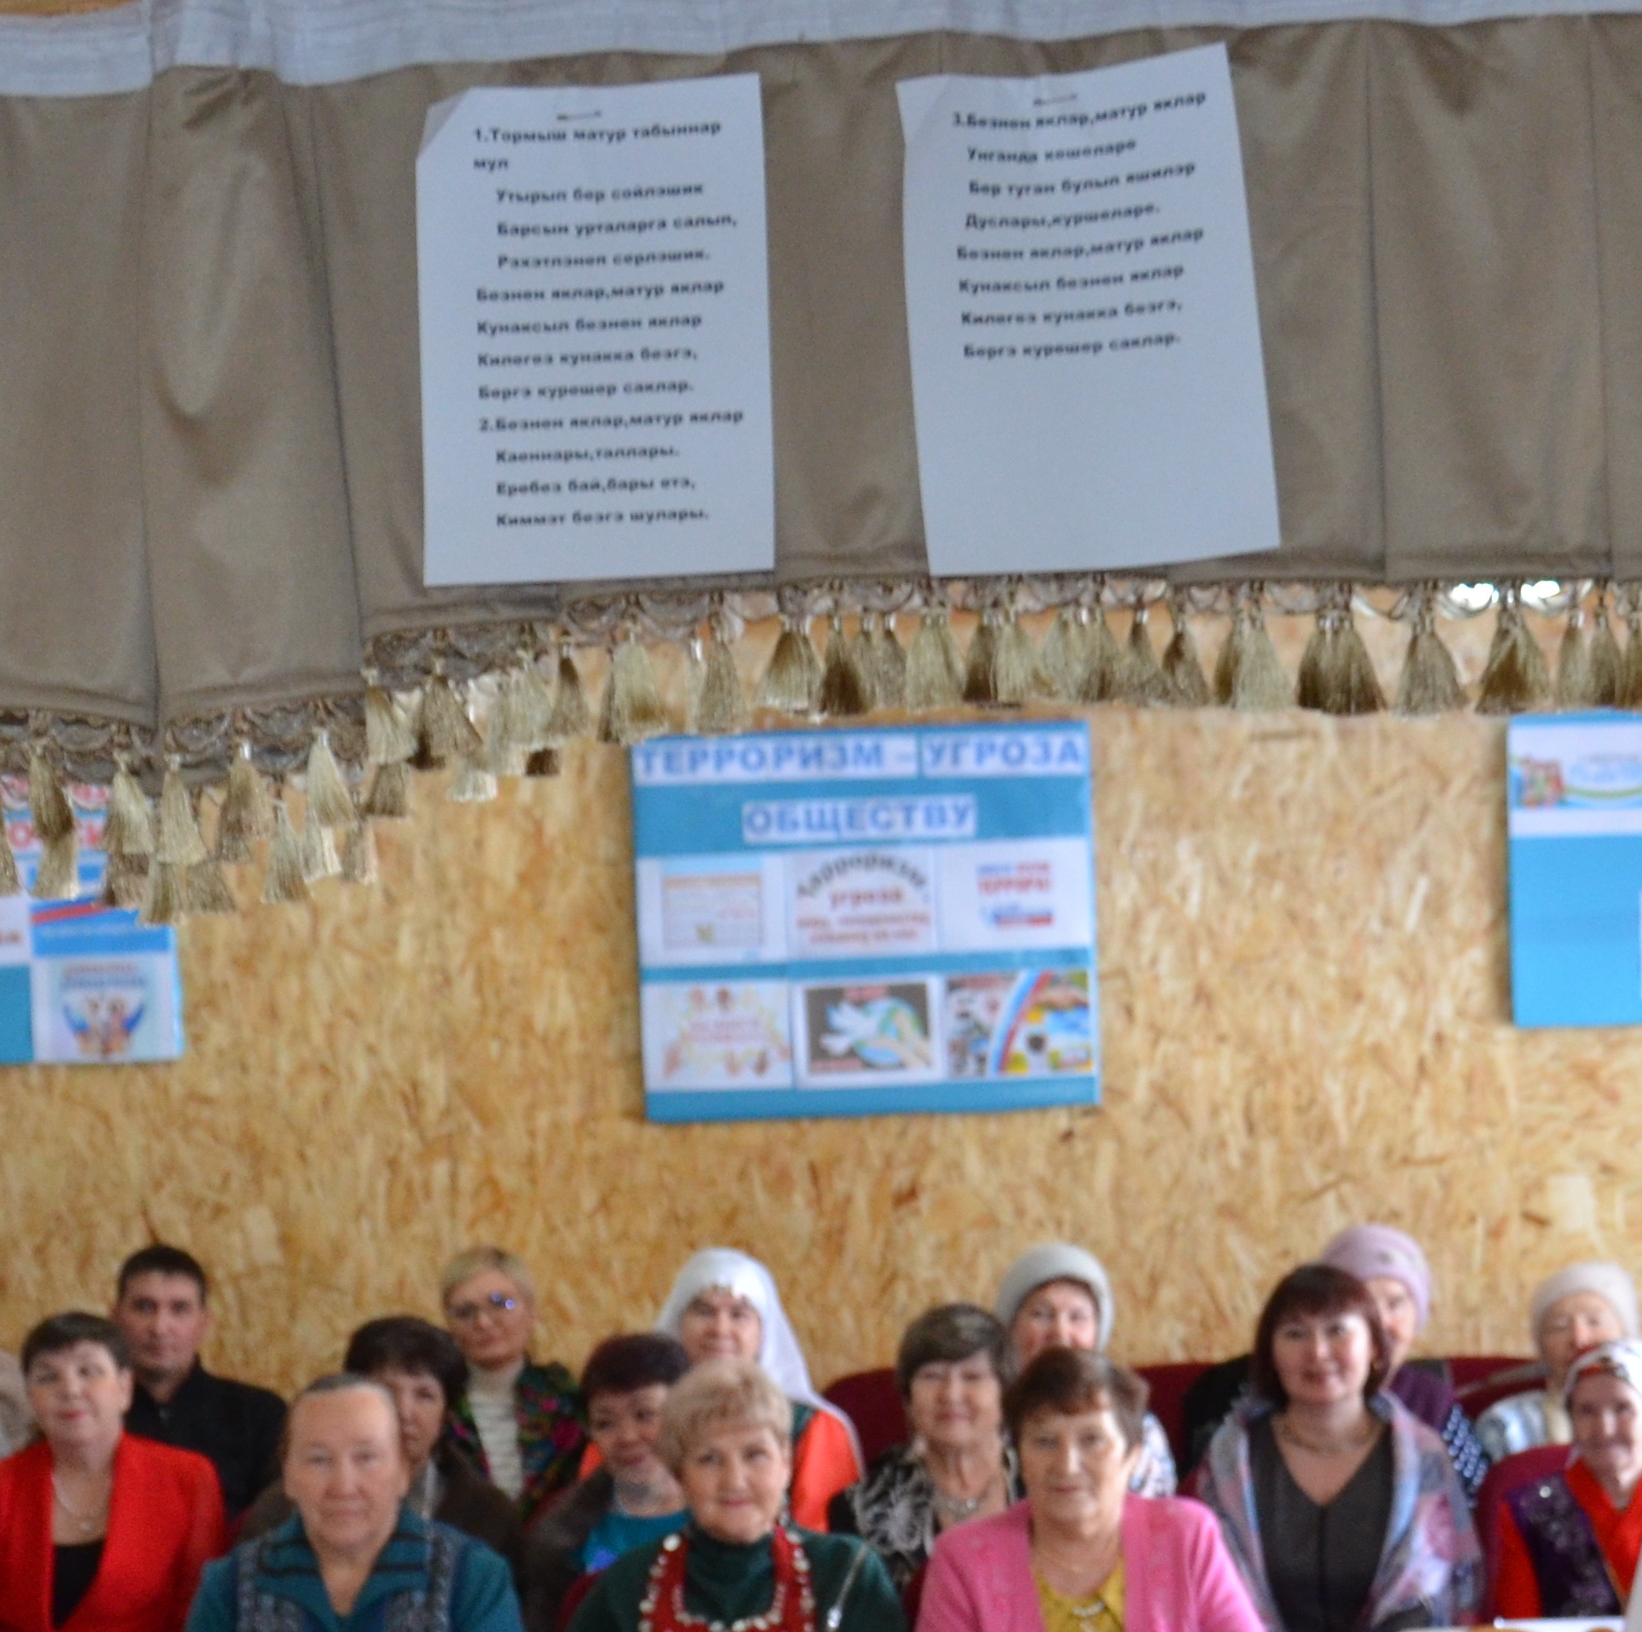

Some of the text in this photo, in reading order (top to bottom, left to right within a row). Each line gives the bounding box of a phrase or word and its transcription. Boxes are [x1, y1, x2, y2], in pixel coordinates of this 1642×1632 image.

[637, 741, 884, 776] ТЕРРОРИЗМ
[927, 738, 1081, 767] УГРОЗА
[745, 802, 971, 837] ОБЩЕСТВУ
